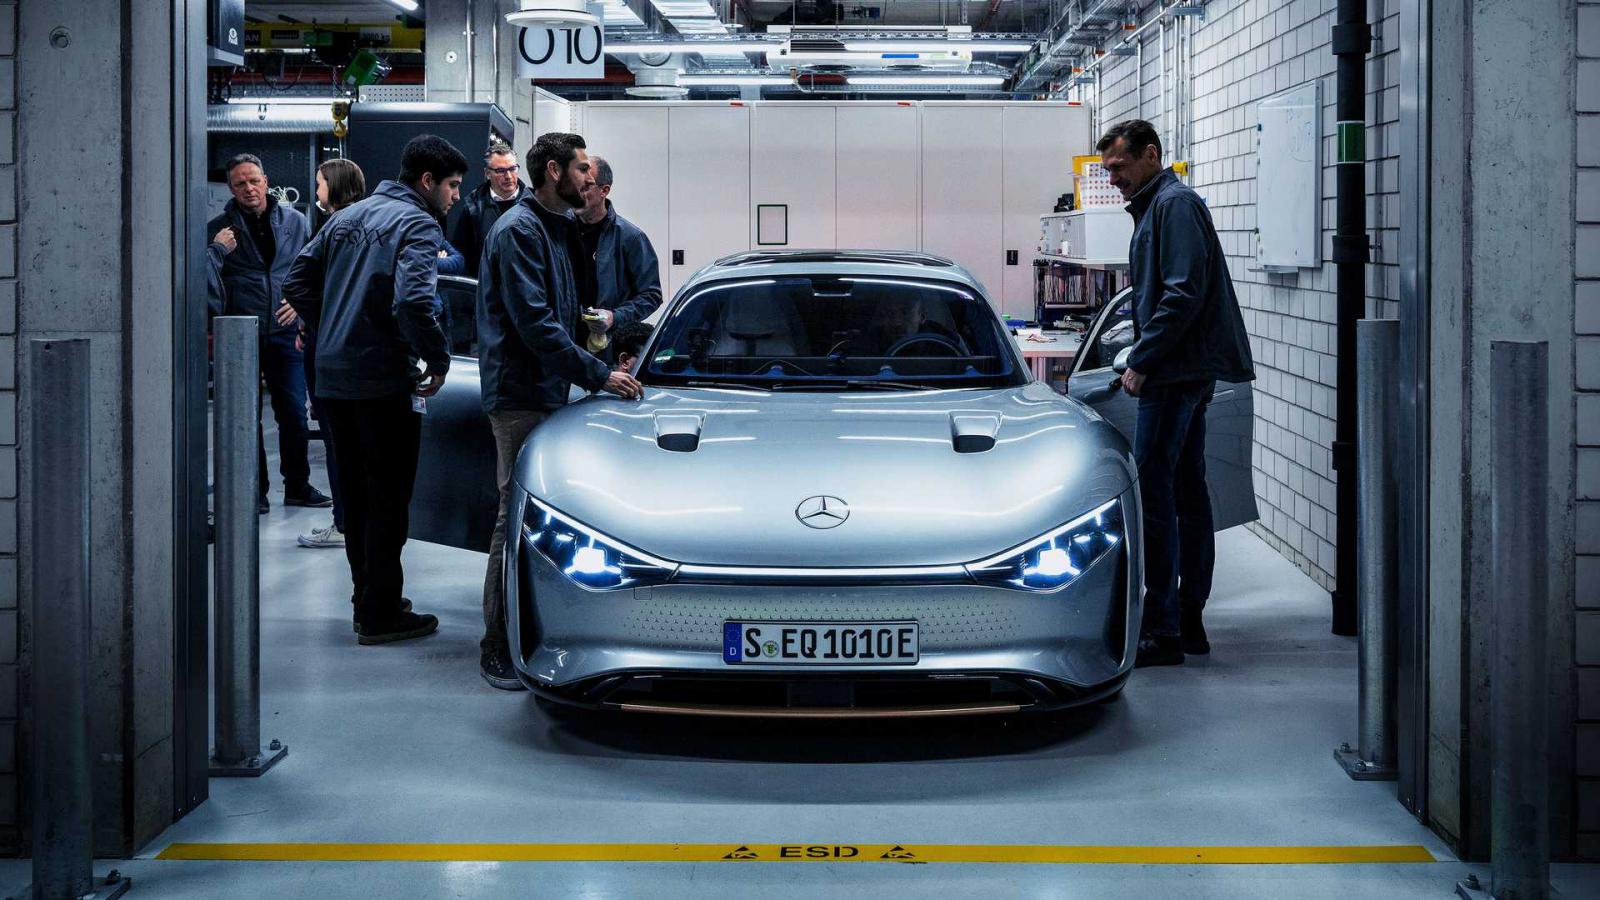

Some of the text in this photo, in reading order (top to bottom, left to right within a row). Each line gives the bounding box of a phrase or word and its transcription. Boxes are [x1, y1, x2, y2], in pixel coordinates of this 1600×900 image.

[333, 226, 388, 248] EQXX
[729, 646, 737, 656] D
[744, 628, 762, 658] S
[779, 846, 860, 858] ESD
